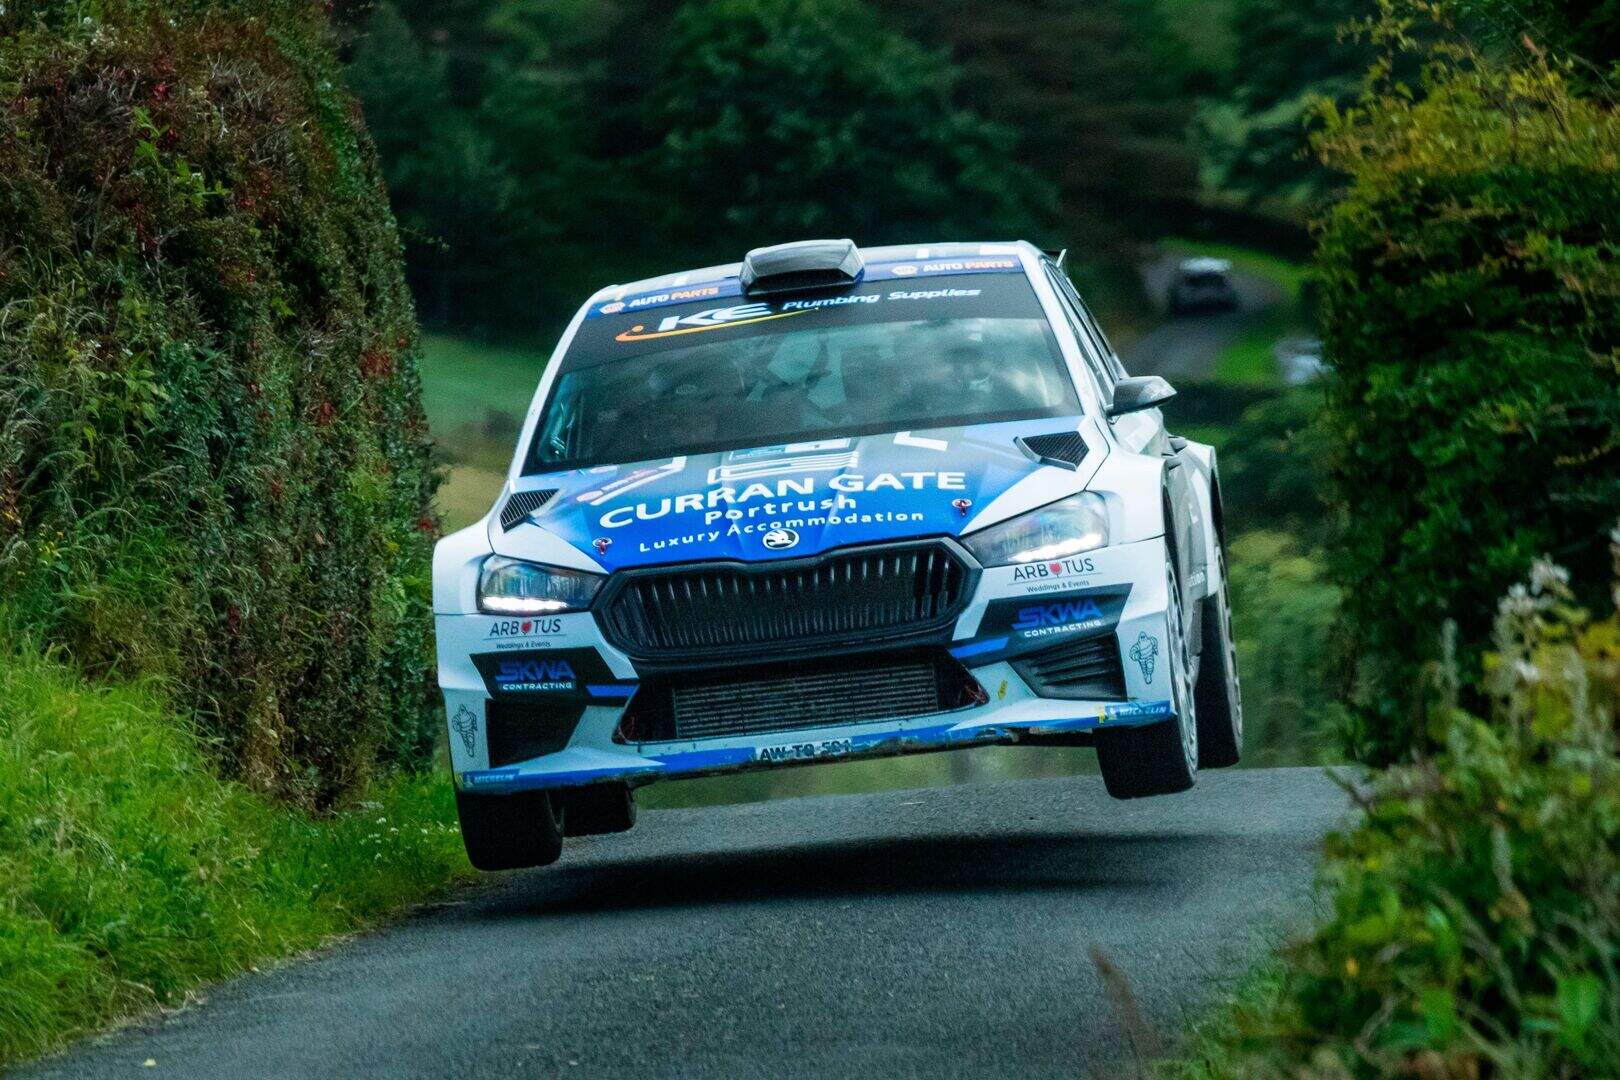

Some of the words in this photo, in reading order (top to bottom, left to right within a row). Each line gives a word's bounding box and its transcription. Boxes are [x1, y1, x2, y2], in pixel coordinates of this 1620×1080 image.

[921, 262, 963, 272] AUTO
[964, 260, 1015, 270] PARTS
[628, 294, 669, 308] AUTO
[670, 287, 719, 300] PARTS
[783, 293, 880, 310] Plumbing
[887, 288, 982, 301] Supplies
[600, 478, 815, 528] CURRAN
[828, 471, 967, 491] GATE
[705, 496, 857, 525] Portrush
[639, 528, 721, 553] Luxury
[726, 511, 925, 536] Accommodation
[1026, 583, 1061, 593] Weddings
[1068, 579, 1090, 590] Events
[1012, 599, 1103, 631] SKWA
[1024, 620, 1102, 638] CONTRACTING
[531, 640, 551, 649] Events
[495, 659, 577, 682] SKWA
[502, 681, 574, 691] CONTRACTING
